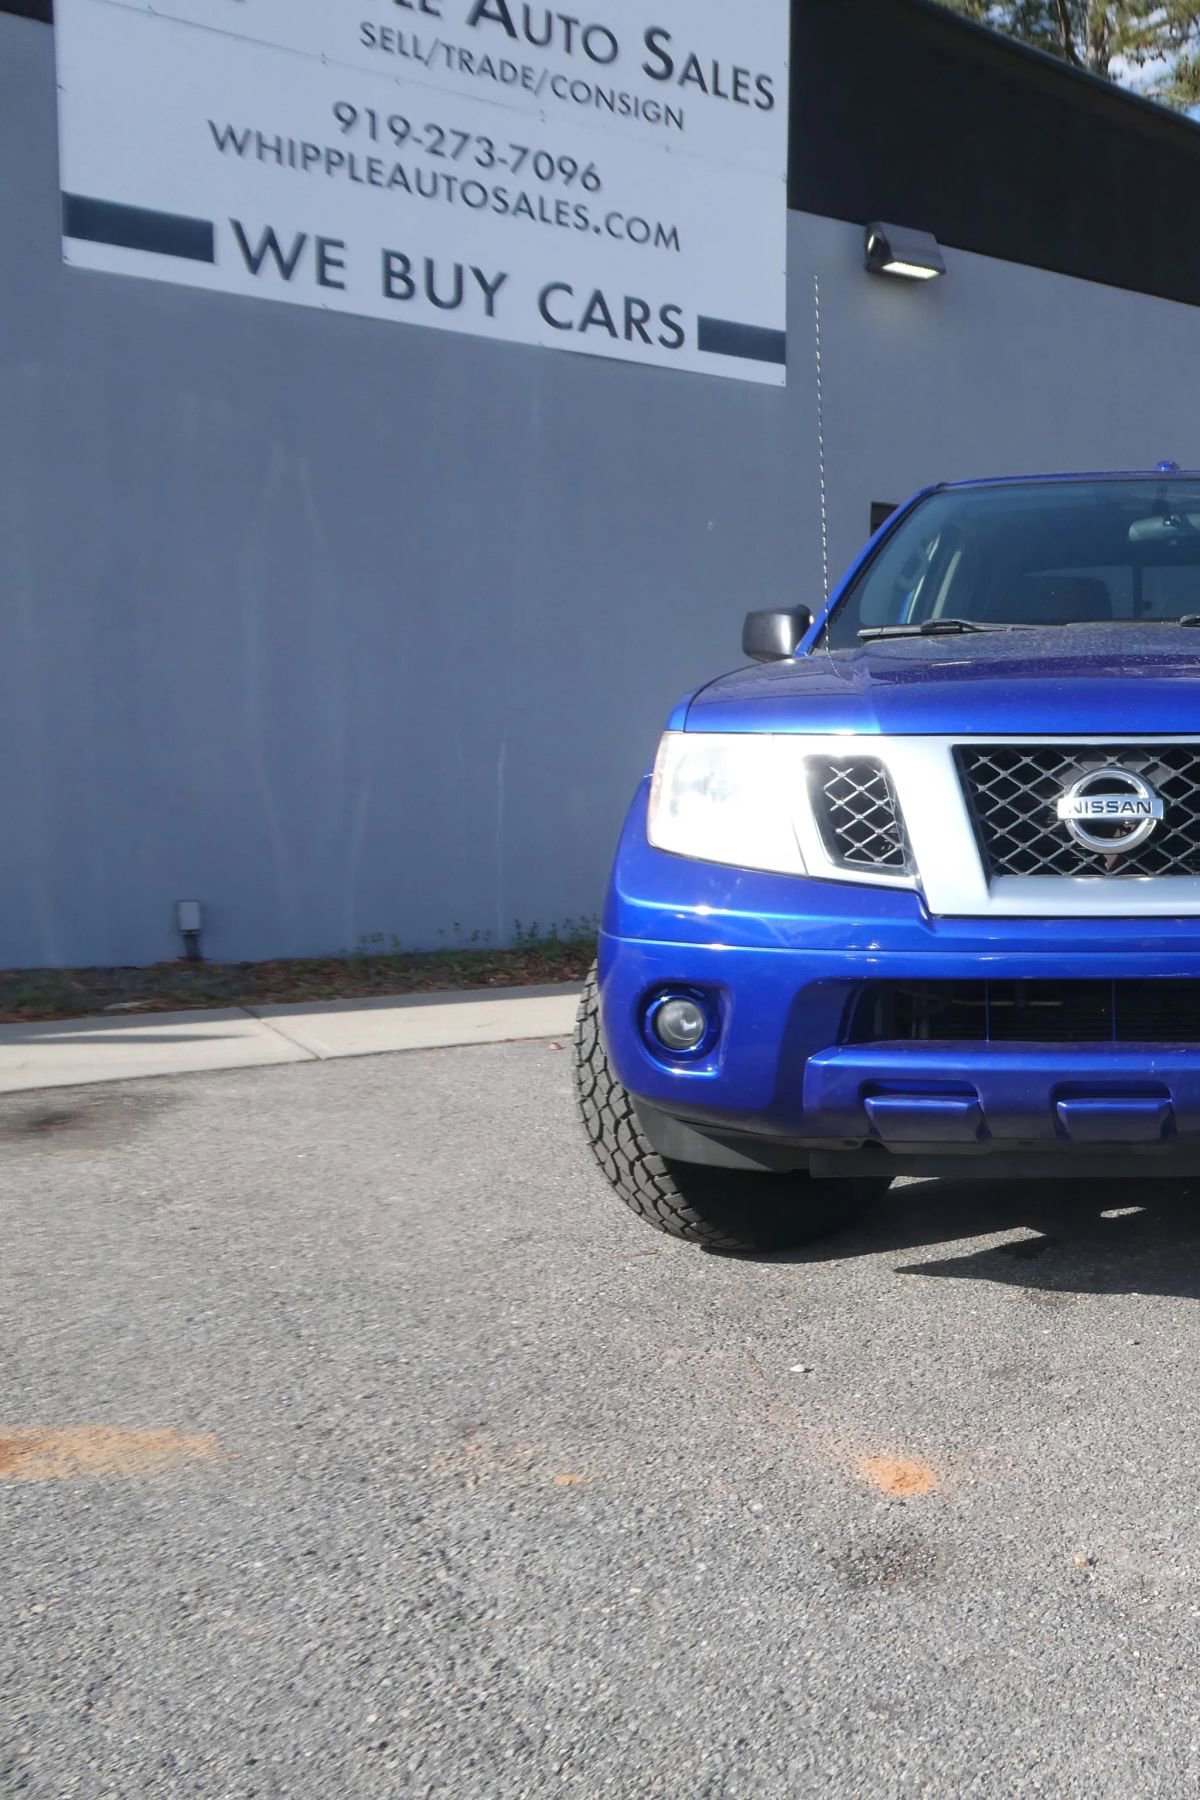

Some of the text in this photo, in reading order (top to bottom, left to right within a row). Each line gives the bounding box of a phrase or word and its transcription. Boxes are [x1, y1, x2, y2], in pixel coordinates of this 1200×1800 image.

[359, 21, 684, 131] SELL/TRADE/CONSIGN
[641, 26, 776, 112] SALES
[207, 119, 681, 253] WHIPPLEAUTOSALES.COM
[332, 101, 602, 193] 919-273-7096
[229, 217, 686, 350] WE BUY CARS
[1068, 800, 1152, 814] NISSAN
